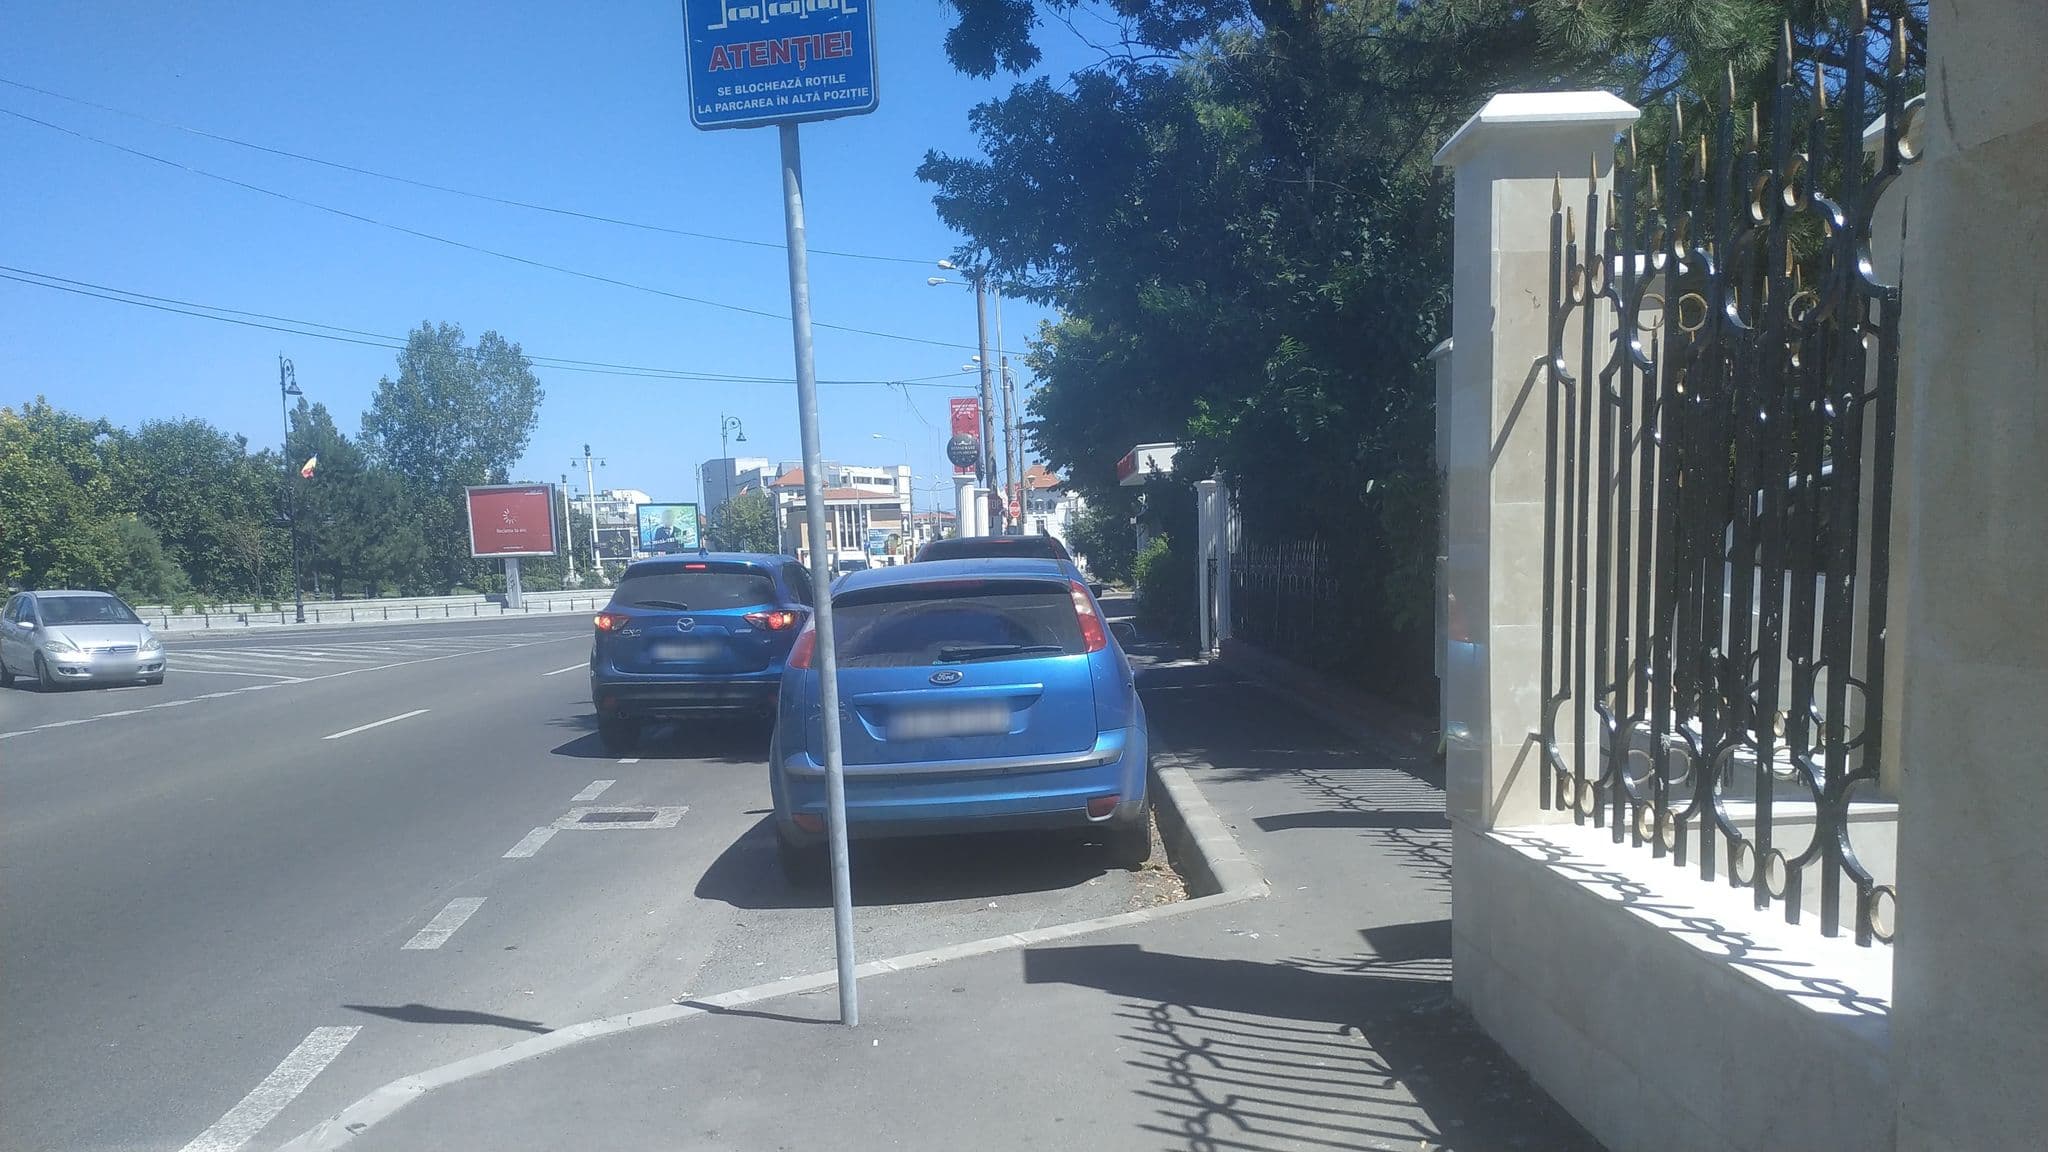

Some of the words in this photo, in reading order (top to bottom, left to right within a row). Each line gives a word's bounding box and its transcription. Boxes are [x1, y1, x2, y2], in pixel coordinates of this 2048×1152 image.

[709, 31, 853, 71] ATENȚIE!
[717, 86, 732, 97] SE
[735, 77, 801, 95] BLOCHEAZĂ
[805, 73, 846, 88] ROȚILE
[698, 104, 712, 114] LA
[715, 97, 774, 112] PARCAREA
[776, 94, 789, 107] ÎN
[824, 87, 869, 101] POZIȚIE
